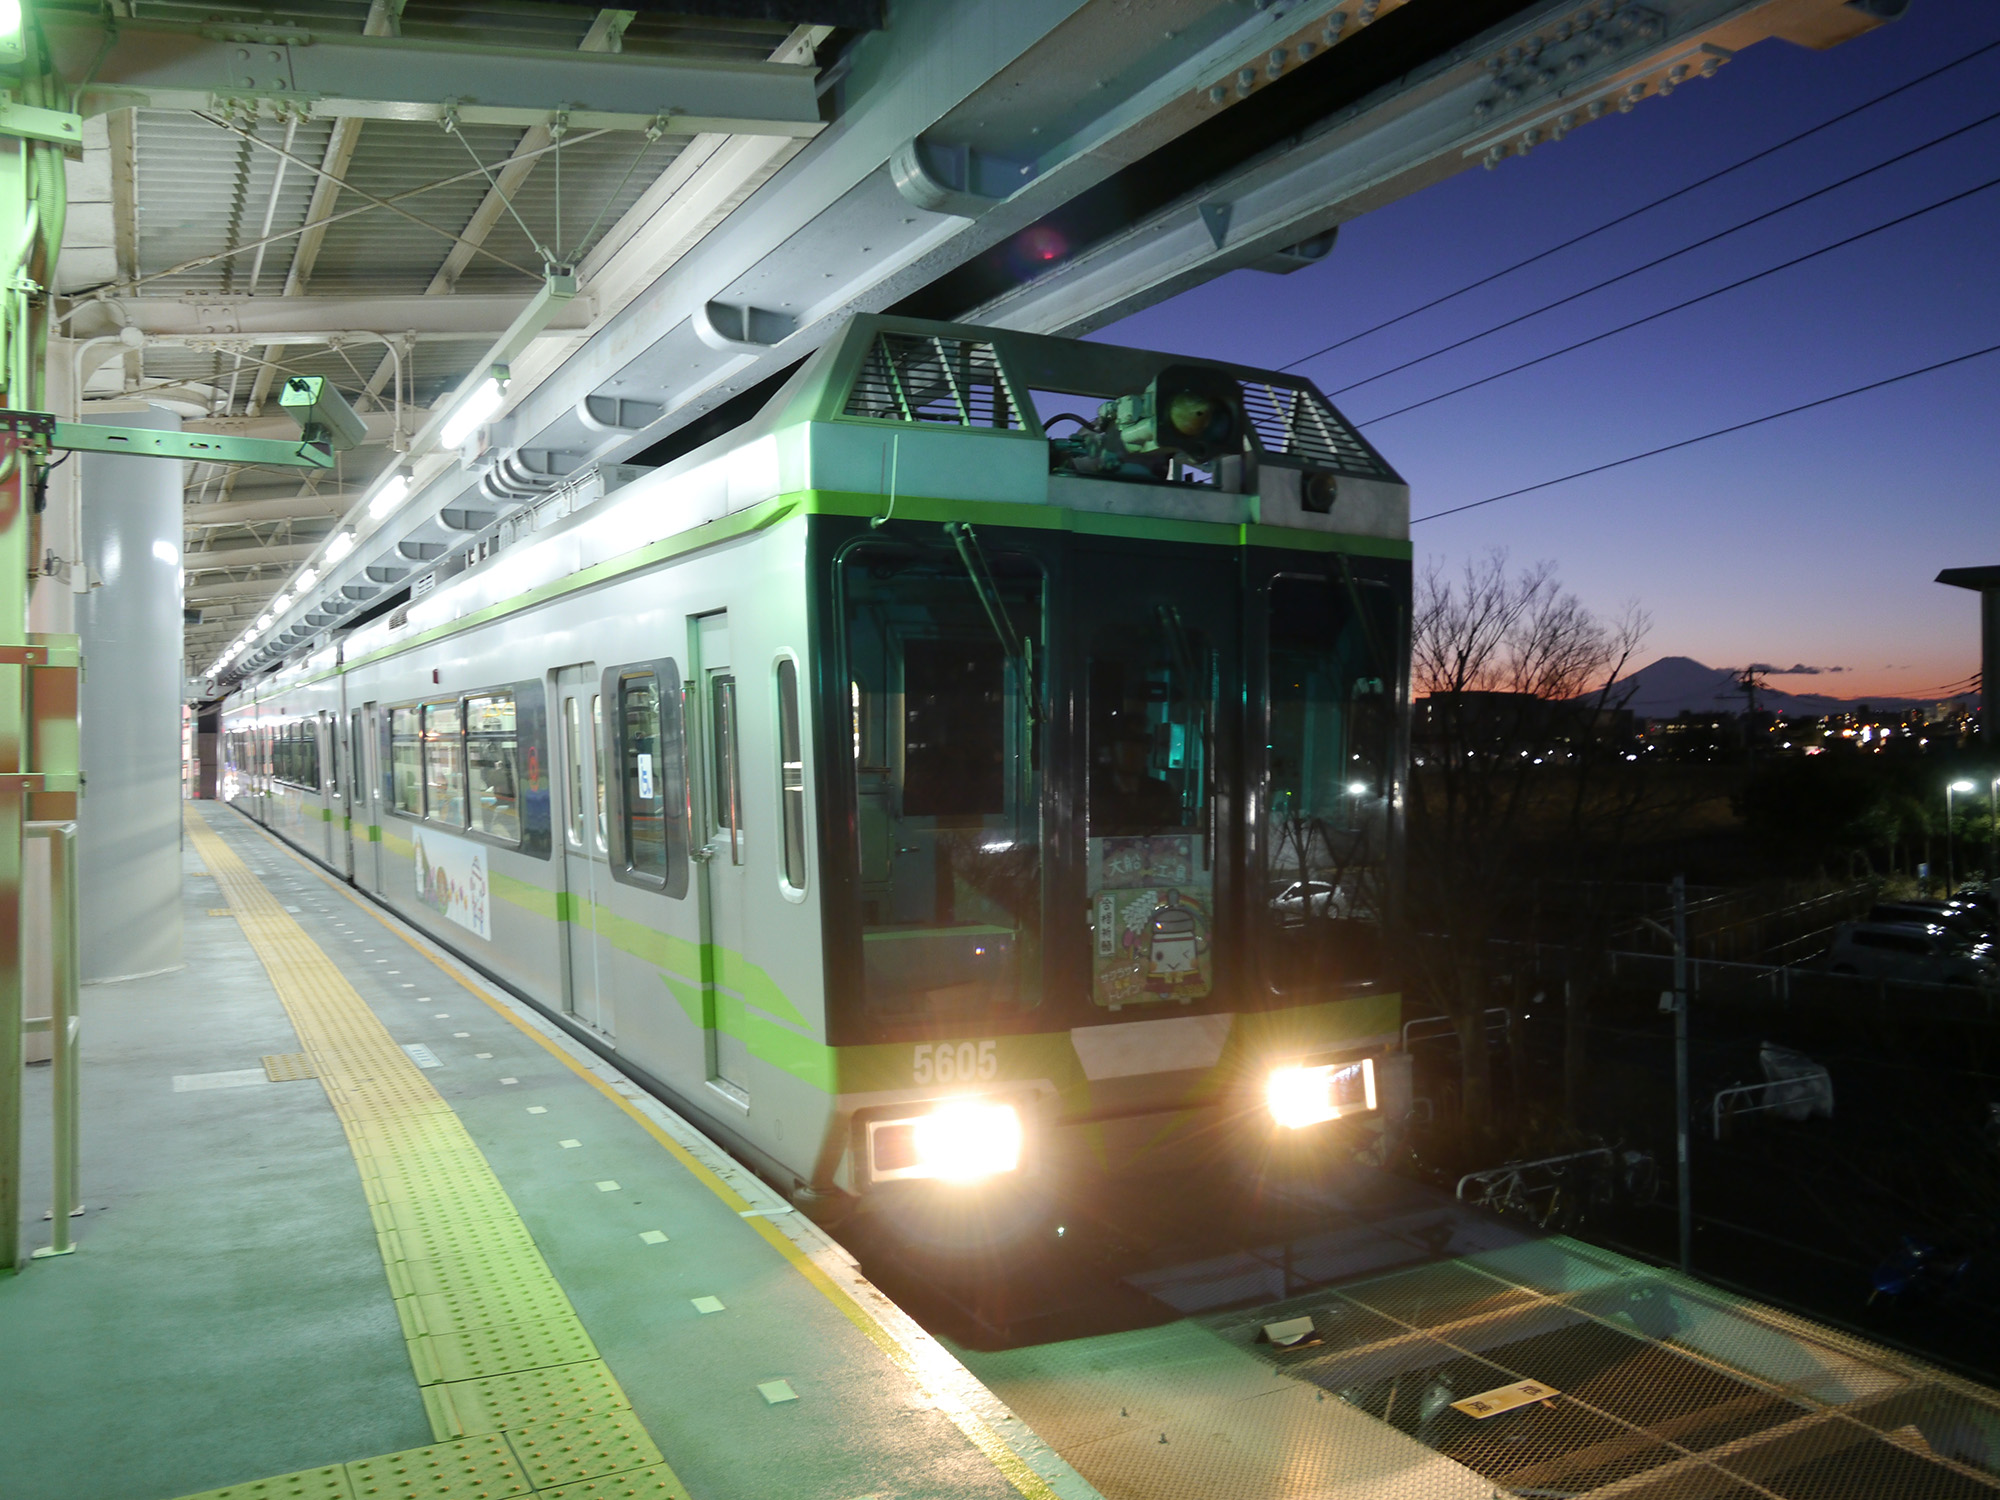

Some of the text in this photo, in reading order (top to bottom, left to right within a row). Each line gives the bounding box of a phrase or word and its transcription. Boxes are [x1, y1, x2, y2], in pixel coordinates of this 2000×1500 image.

[206, 679, 214, 696] 2
[1108, 853, 1142, 877] 大船
[913, 1039, 998, 1085] 5605
[1465, 1384, 1543, 1413] 危険
